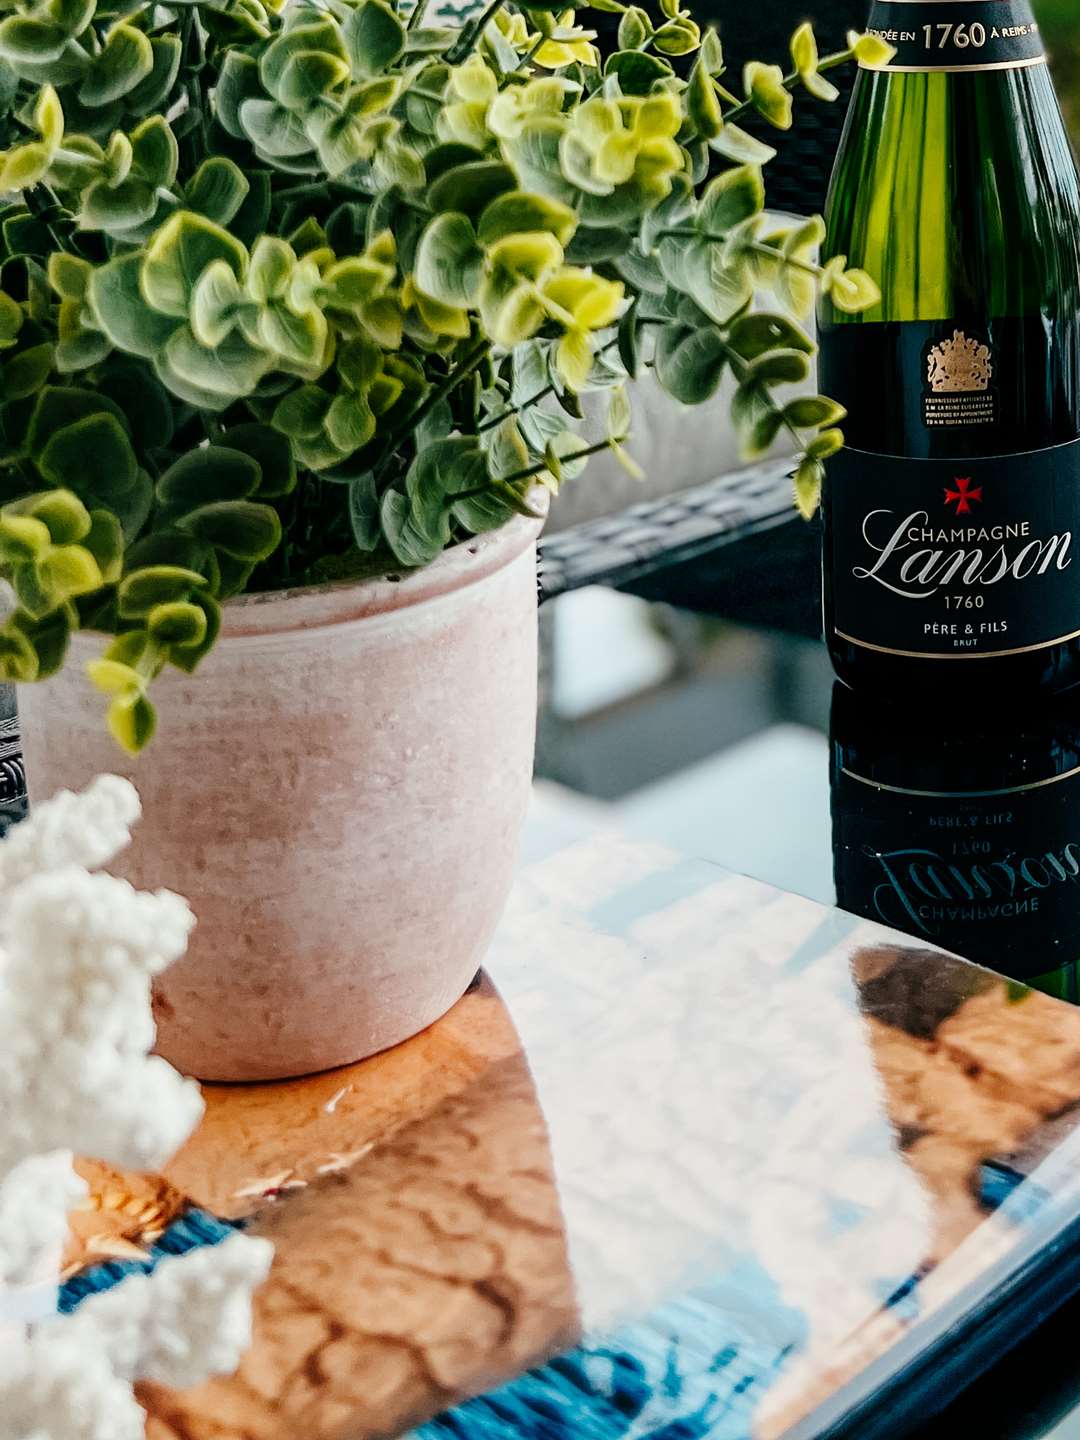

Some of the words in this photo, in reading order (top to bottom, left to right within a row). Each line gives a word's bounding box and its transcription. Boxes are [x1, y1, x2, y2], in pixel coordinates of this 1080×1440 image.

[900, 31, 915, 41] EN
[922, 22, 986, 49] 1760
[907, 521, 1030, 543] CHAMPAGNE
[852, 509, 1072, 598] Lanson
[944, 595, 984, 609] 1760
[924, 621, 957, 635] PÈRE
[964, 623, 974, 635] &
[980, 620, 1008, 633] FILS
[953, 638, 978, 647] BRUT
